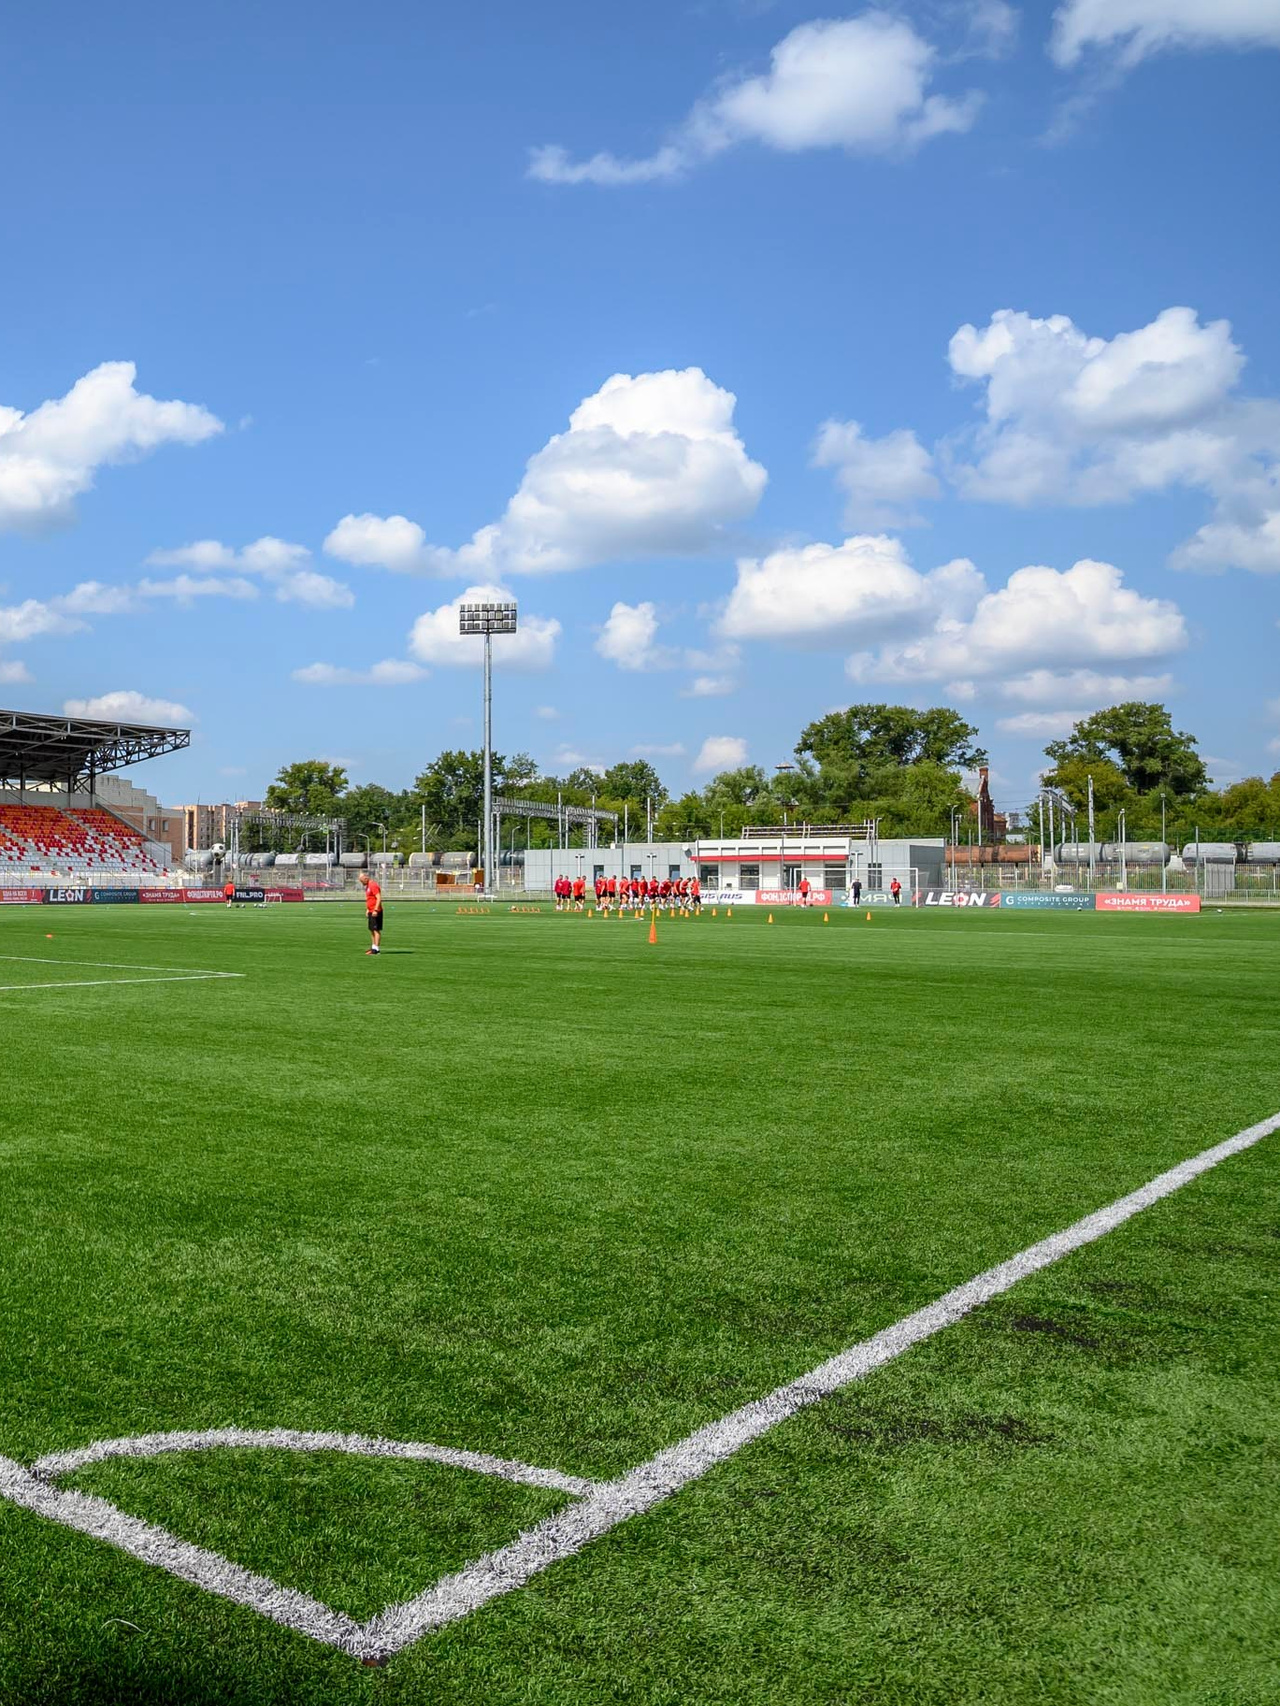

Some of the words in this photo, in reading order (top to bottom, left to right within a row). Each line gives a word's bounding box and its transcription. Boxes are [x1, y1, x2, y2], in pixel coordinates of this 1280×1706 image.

[49, 889, 84, 902] LEON
[925, 892, 987, 907] LEON
[1104, 898, 1148, 906] «ЗНАМЯ
[1150, 898, 1191, 907] ТРУДА»
